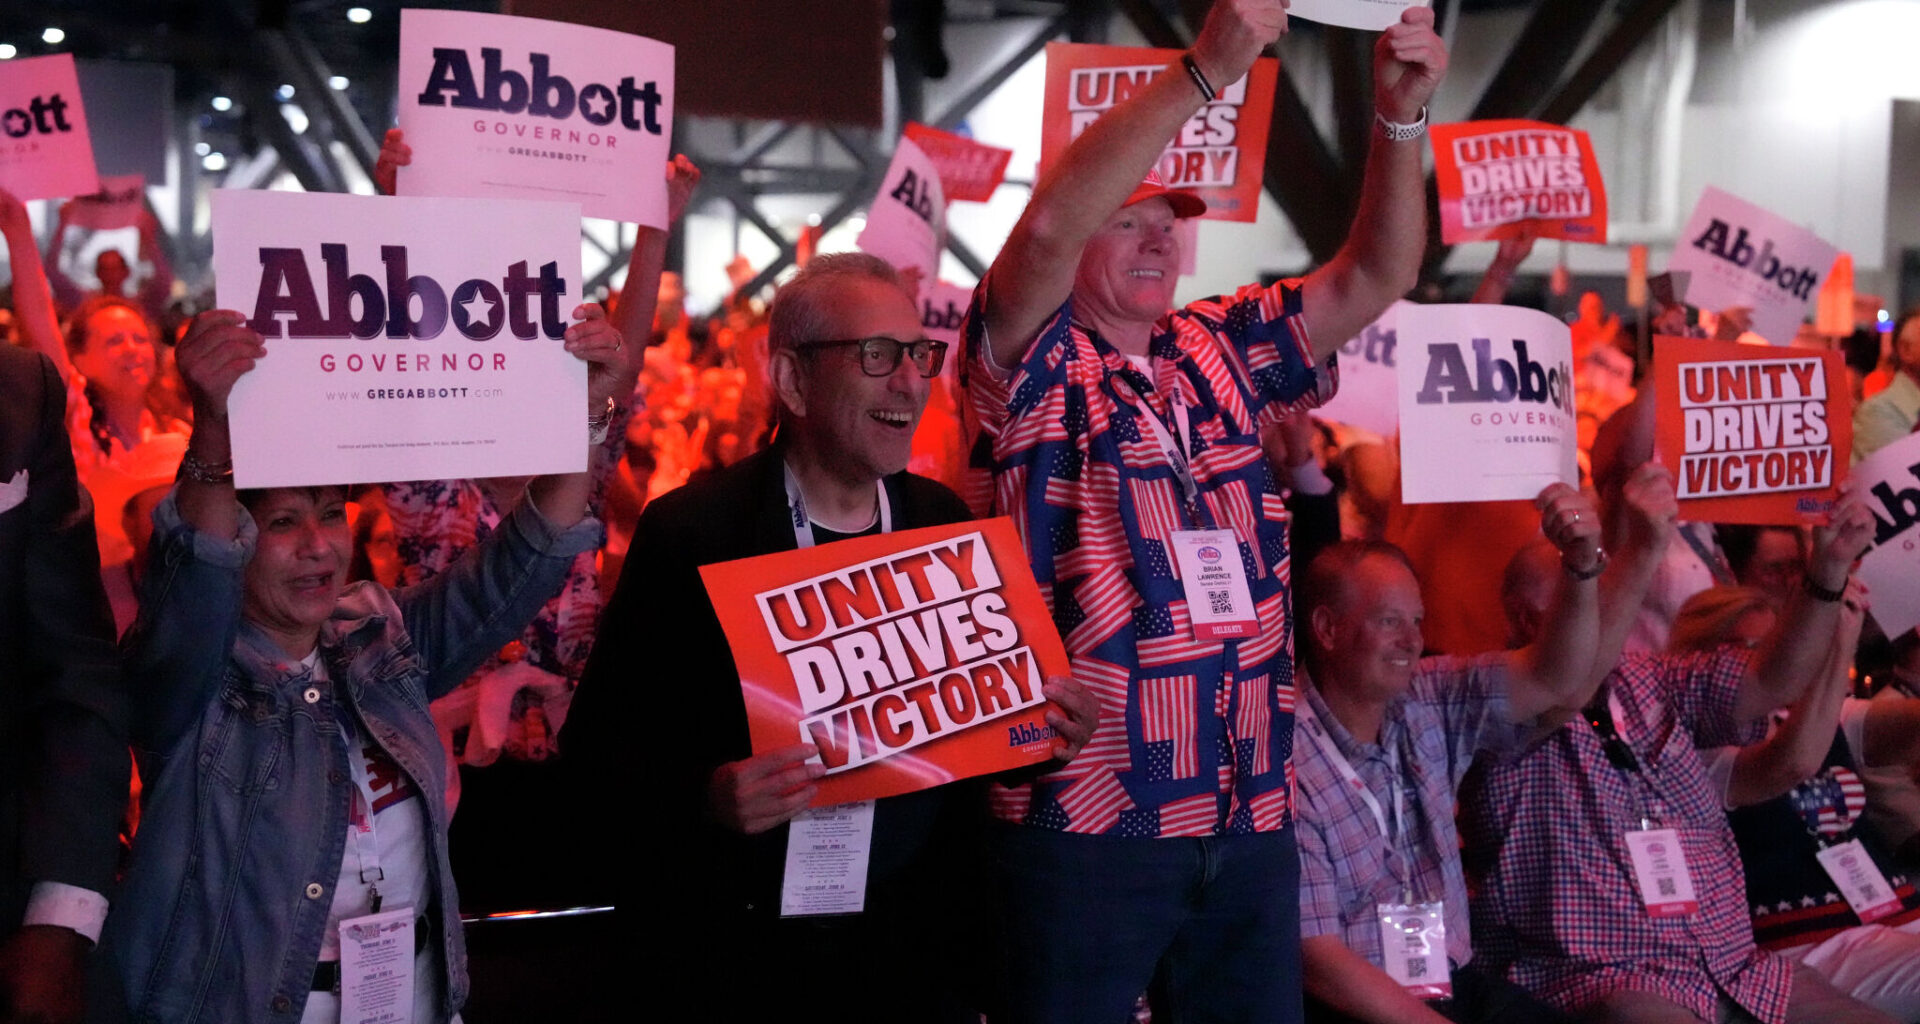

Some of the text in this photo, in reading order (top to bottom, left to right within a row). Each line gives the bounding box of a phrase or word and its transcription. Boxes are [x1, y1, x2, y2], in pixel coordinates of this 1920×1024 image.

[417, 47, 662, 135] Abbott
[2, 93, 72, 138] ott
[474, 119, 618, 148] GOVERNOR
[477, 146, 614, 164] GREGABBOTT
[1459, 134, 1569, 163] UNITY
[1461, 157, 1585, 195] DRIVES
[1466, 191, 1586, 223] VICTORY
[1693, 217, 1818, 301] Abbott
[246, 242, 568, 341] Abbott
[320, 352, 507, 373] GOVERNOR
[1416, 338, 1574, 418] Abbott
[1684, 362, 1817, 403] UNITY
[1471, 412, 1562, 428] GOVERN
[1684, 401, 1829, 453] DRIVES
[1685, 449, 1829, 494] VICTORY
[1197, 573, 1232, 581] LAWRENCE
[1202, 565, 1223, 573] BRIAN
[766, 539, 976, 642] UNITY
[1212, 625, 1243, 635] DELEGATE
[786, 592, 1019, 715] DRIVES
[806, 651, 1035, 769] VICTORY
